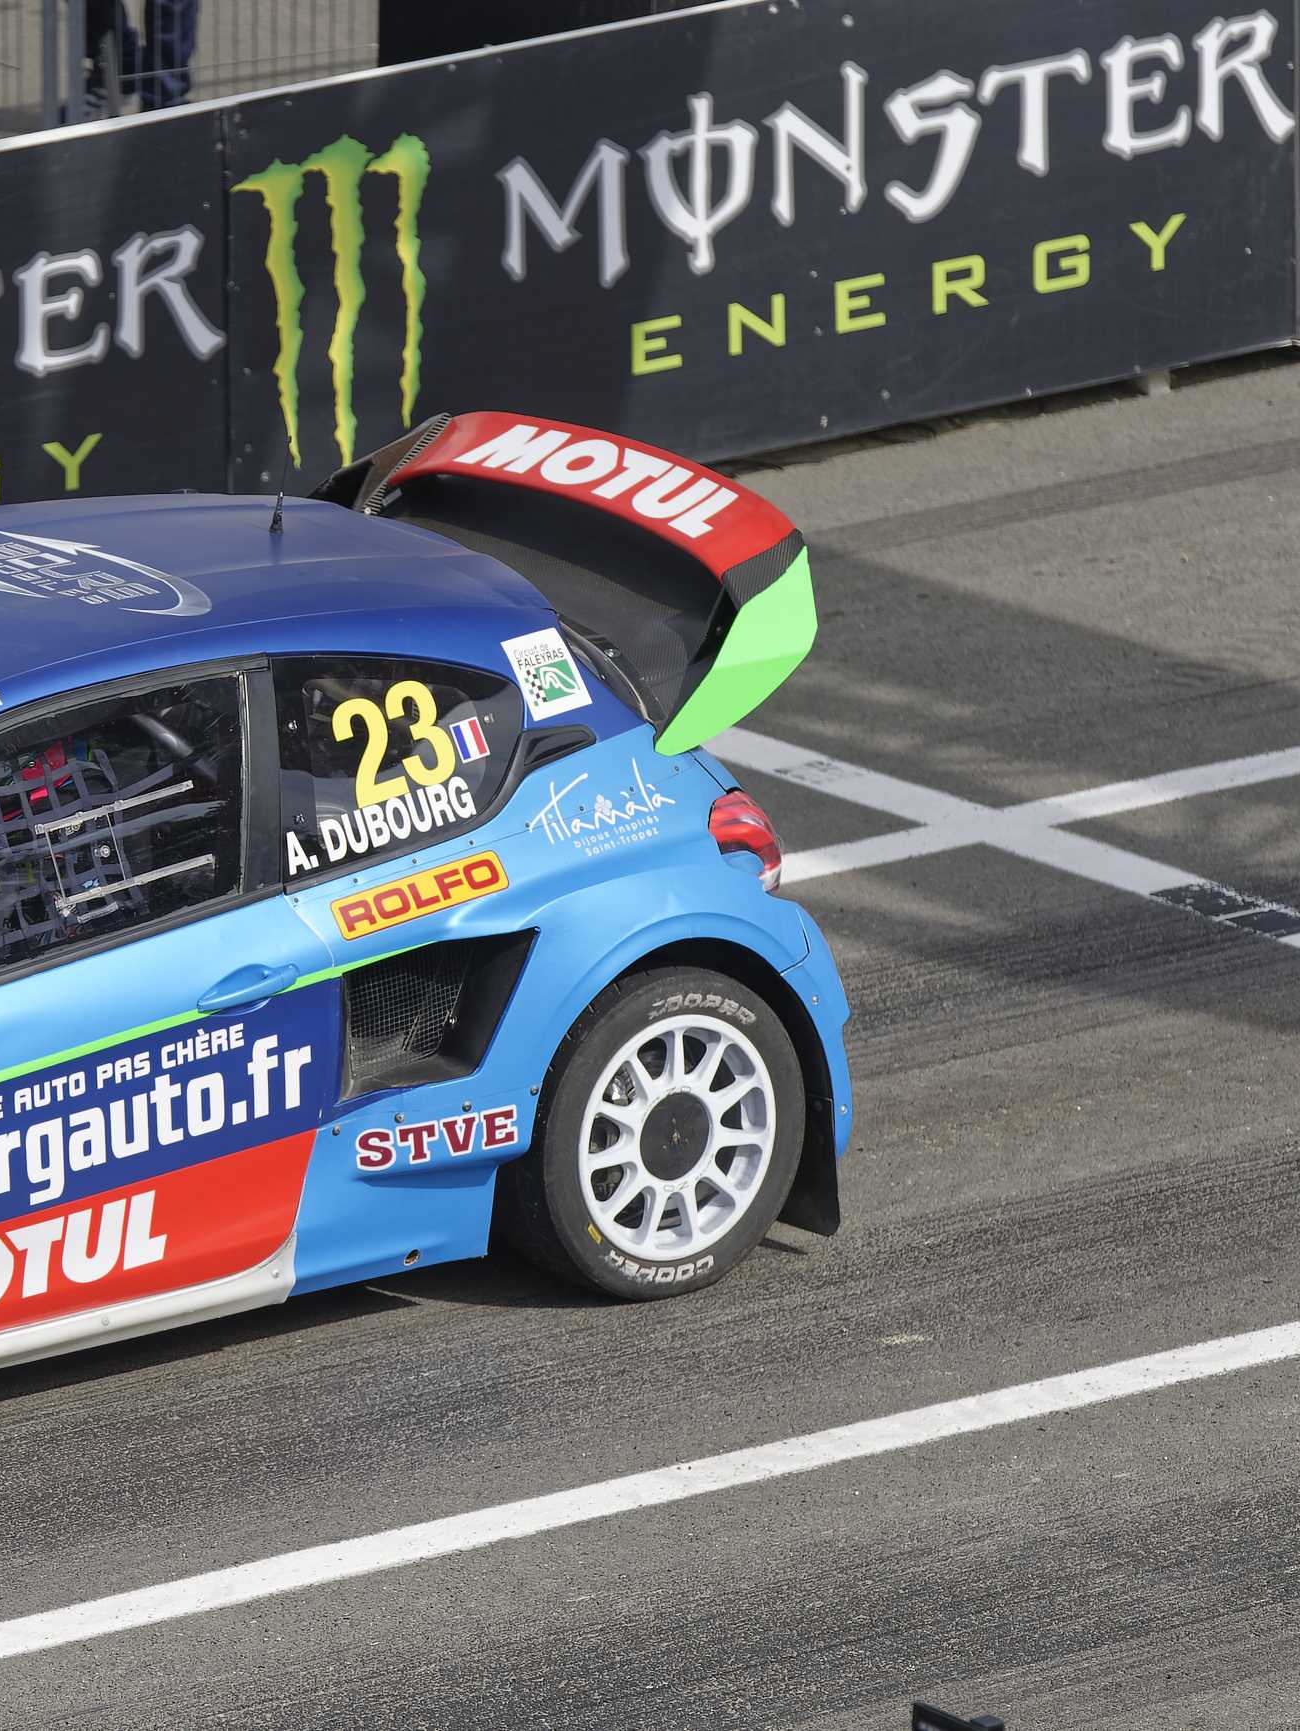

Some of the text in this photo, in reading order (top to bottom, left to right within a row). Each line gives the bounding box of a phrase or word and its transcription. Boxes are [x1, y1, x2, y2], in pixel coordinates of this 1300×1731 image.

[497, 8, 1298, 288] MONSTER
[631, 213, 1188, 376] ENERGY
[453, 424, 738, 539] MOTUL
[517, 648, 565, 668] FALEYRAS
[331, 680, 456, 809] 23
[286, 776, 477, 876] A. DUBOURG
[337, 858, 501, 931] ROLFO
[14, 1068, 84, 1114] AUTO
[96, 1051, 151, 1093] PAS
[160, 1022, 246, 1069] CHÈRE
[356, 1104, 519, 1172] STVE
